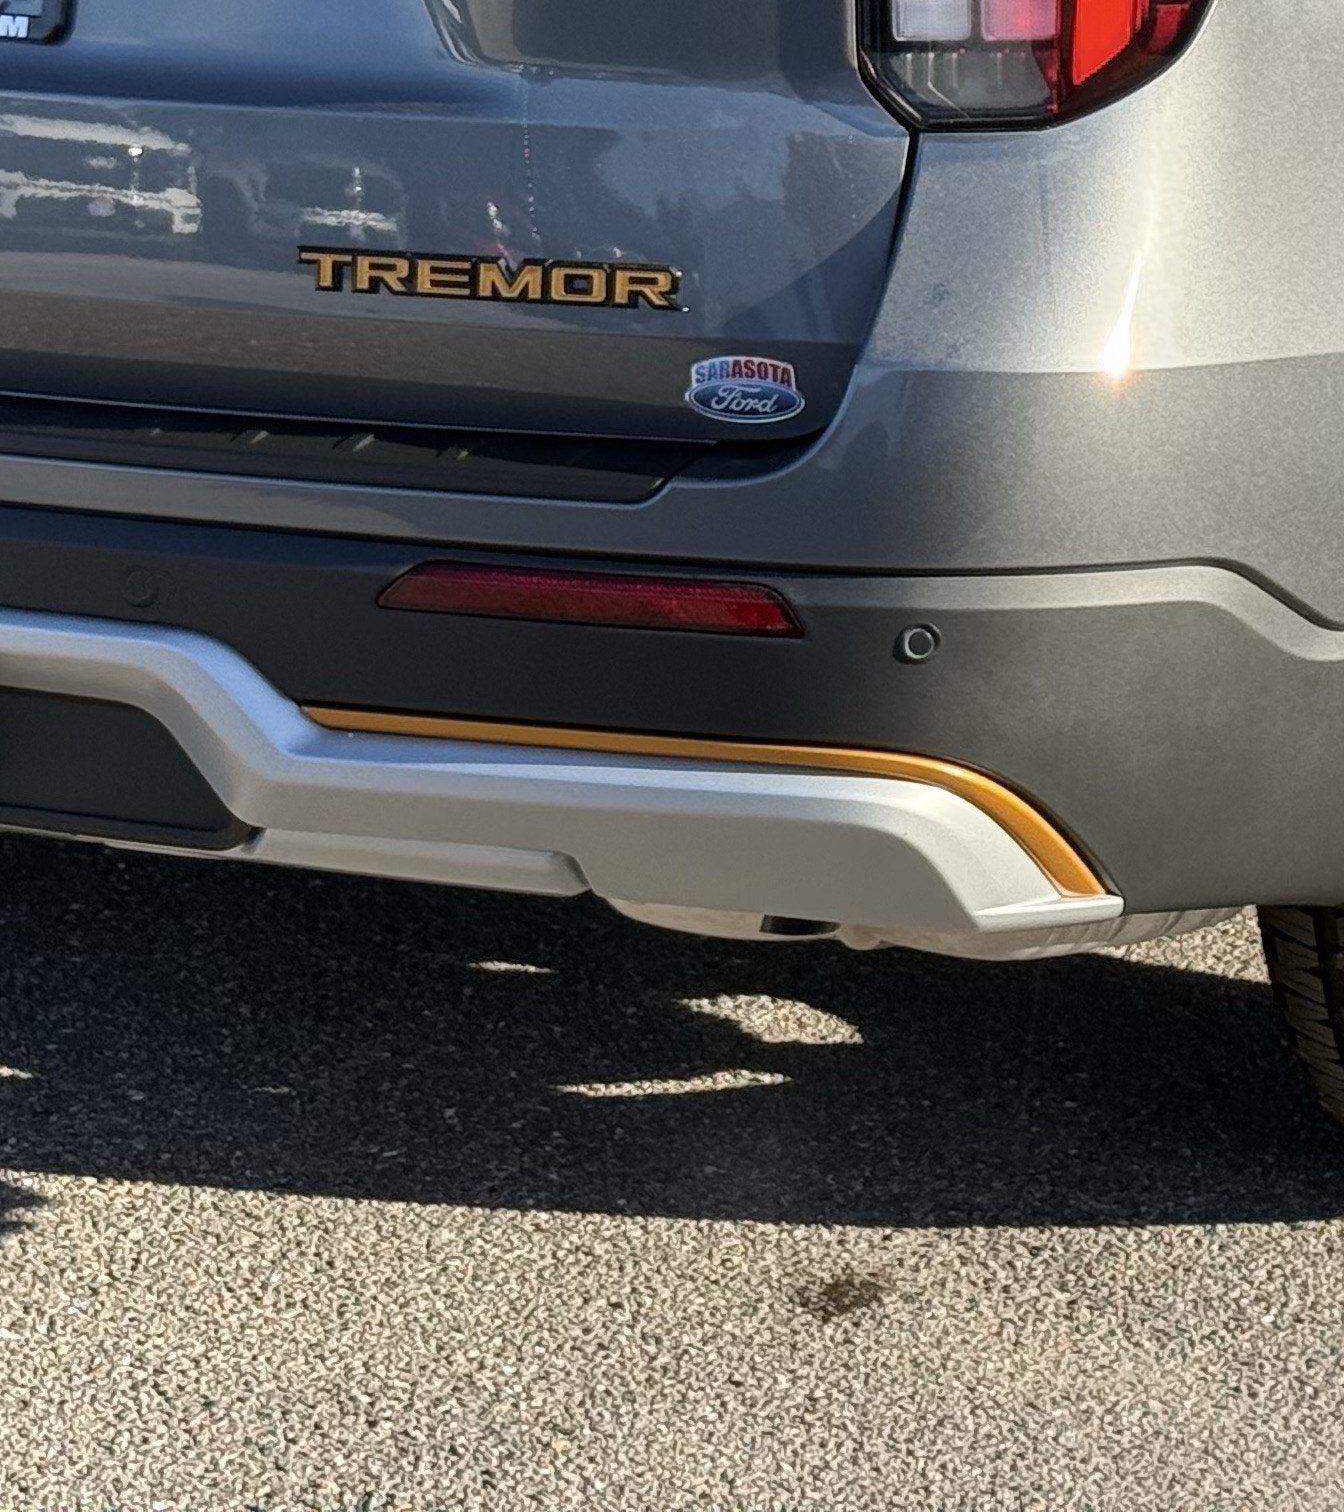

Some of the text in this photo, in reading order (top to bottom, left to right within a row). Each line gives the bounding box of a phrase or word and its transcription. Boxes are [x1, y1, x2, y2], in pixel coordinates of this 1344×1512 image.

[297, 245, 689, 311] TREMOR
[694, 359, 793, 388] SARASOTA
[710, 386, 779, 413] Ford
